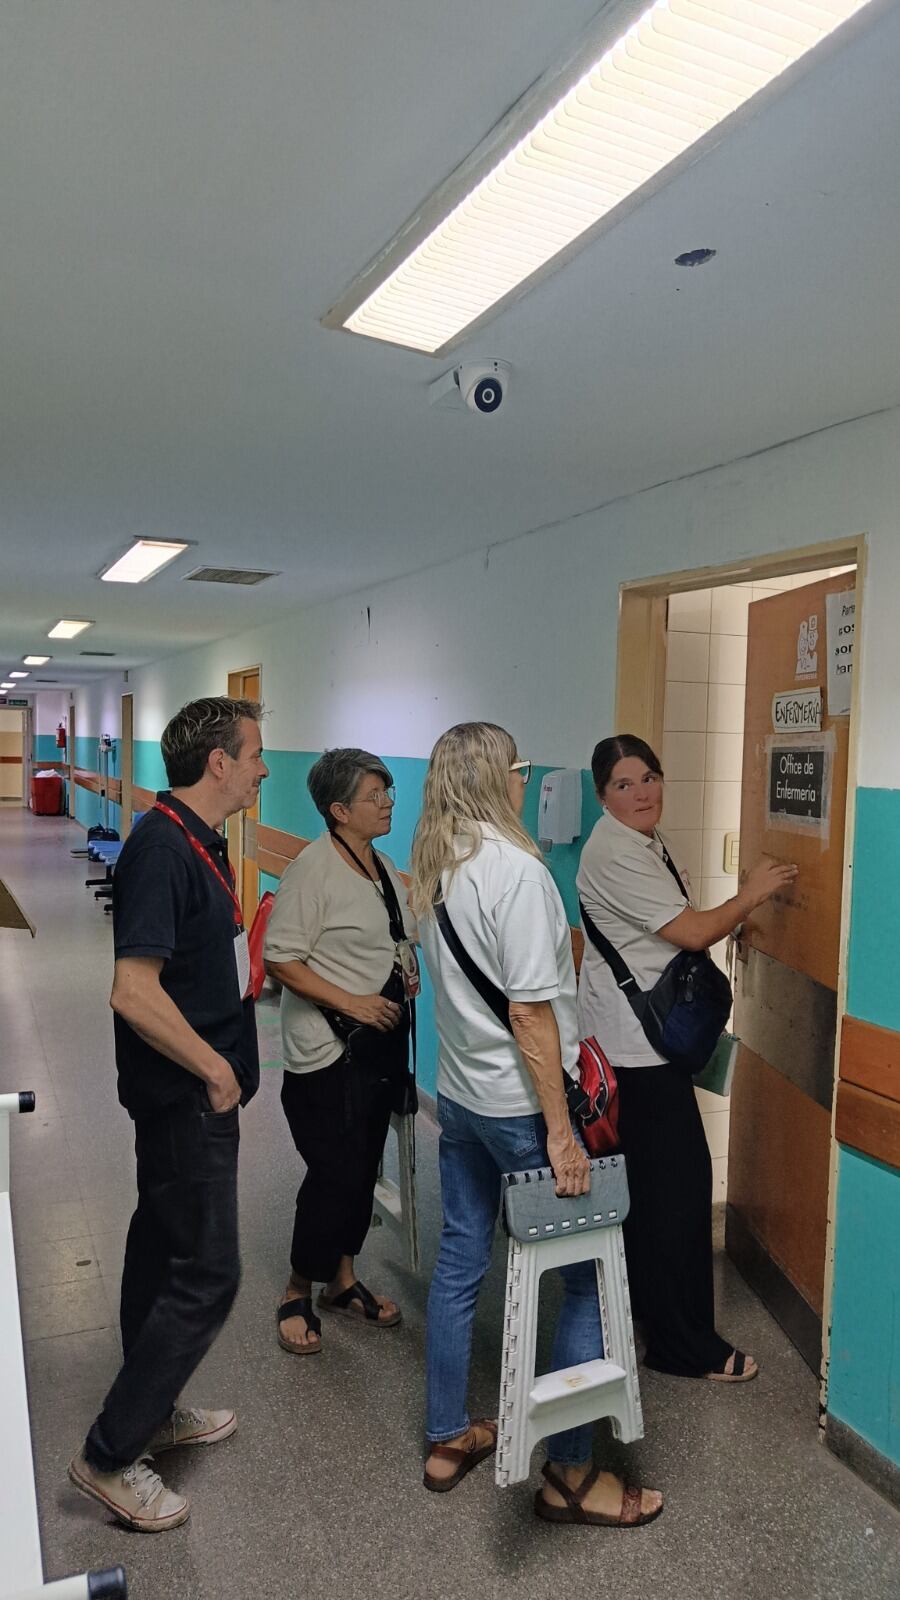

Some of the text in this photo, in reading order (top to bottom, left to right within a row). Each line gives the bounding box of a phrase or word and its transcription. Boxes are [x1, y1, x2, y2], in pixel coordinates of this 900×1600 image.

[780, 753, 814, 775] Office de
[776, 779, 816, 802] Enfermería
